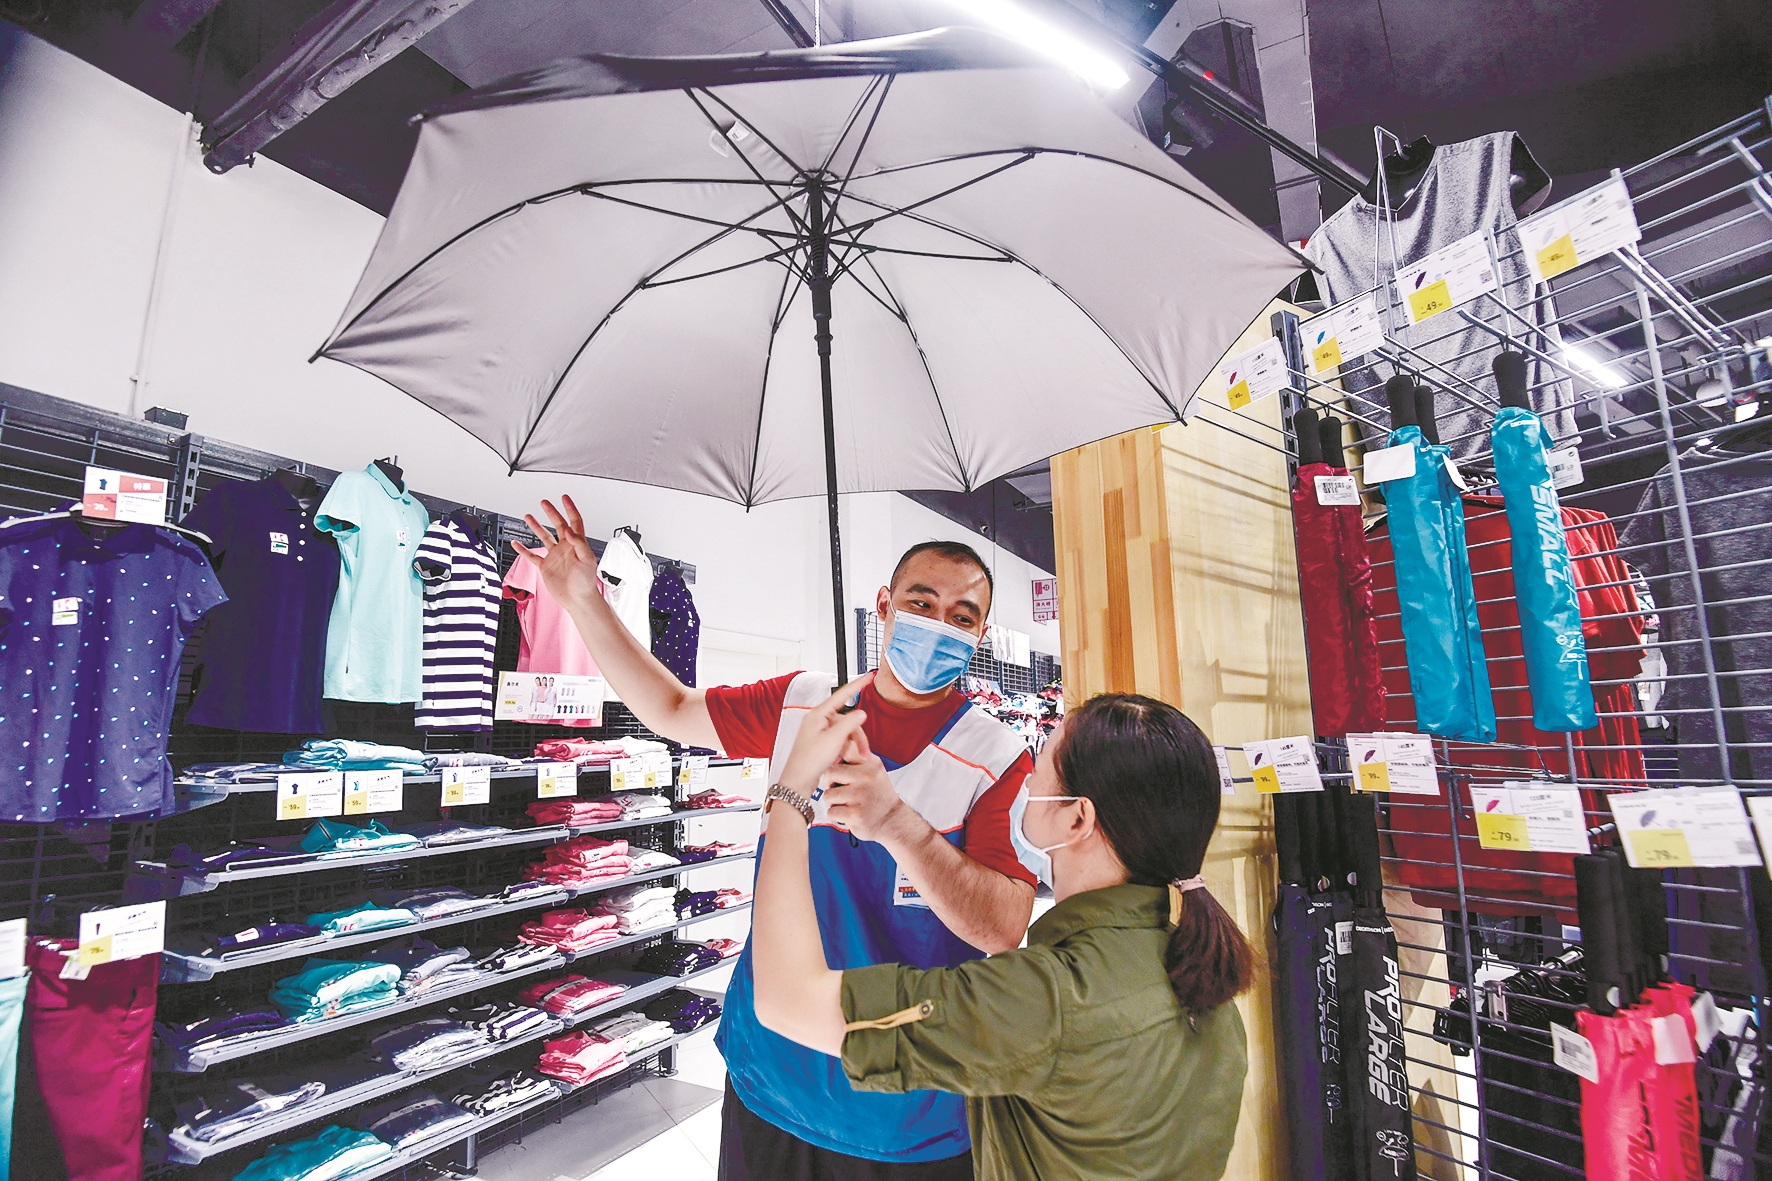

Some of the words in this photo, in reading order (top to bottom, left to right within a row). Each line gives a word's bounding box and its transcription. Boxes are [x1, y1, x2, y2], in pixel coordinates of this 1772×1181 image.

[1529, 484, 1565, 586] SMALL
[1319, 926, 1341, 1066] PROFILTER
[1364, 988, 1392, 1107] LARGE
[1376, 954, 1409, 1113] PROFILTER
